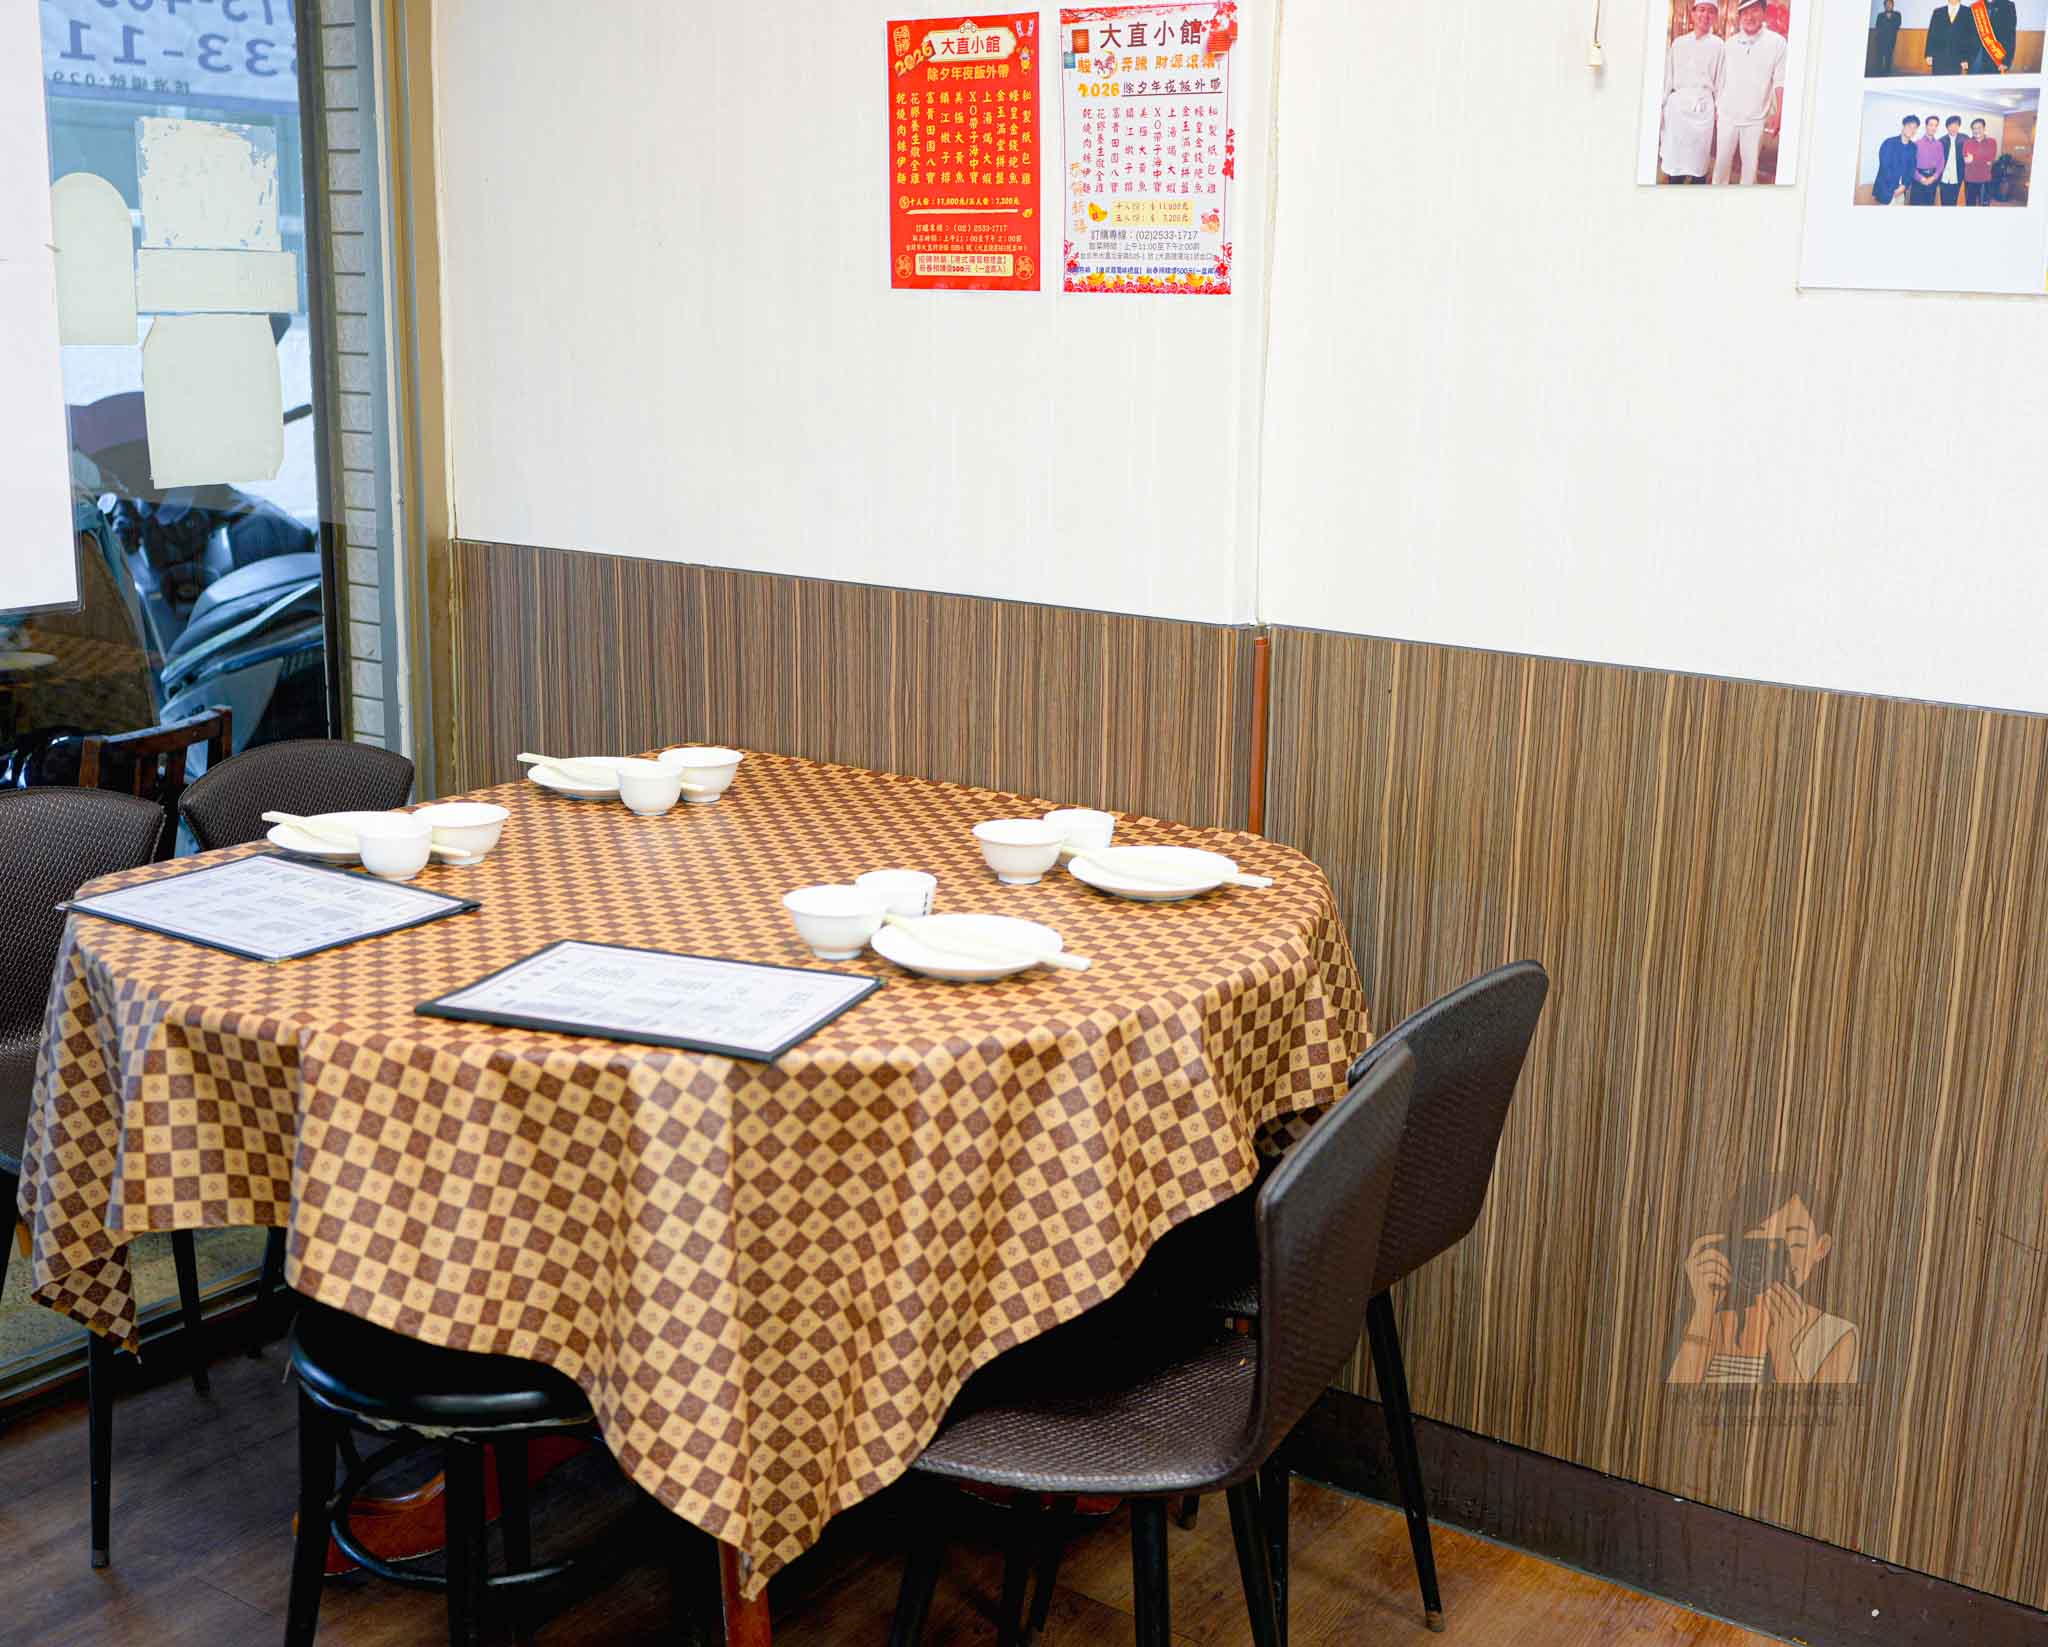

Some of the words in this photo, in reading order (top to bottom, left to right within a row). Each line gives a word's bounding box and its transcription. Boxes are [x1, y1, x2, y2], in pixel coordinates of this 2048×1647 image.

[1099, 19, 1202, 49] 大直小館
[941, 35, 1001, 55] 大直小館
[895, 42, 933, 78] 2026
[927, 64, 1010, 82] 除夕年夜飯外帶
[1078, 82, 1120, 97] 2026
